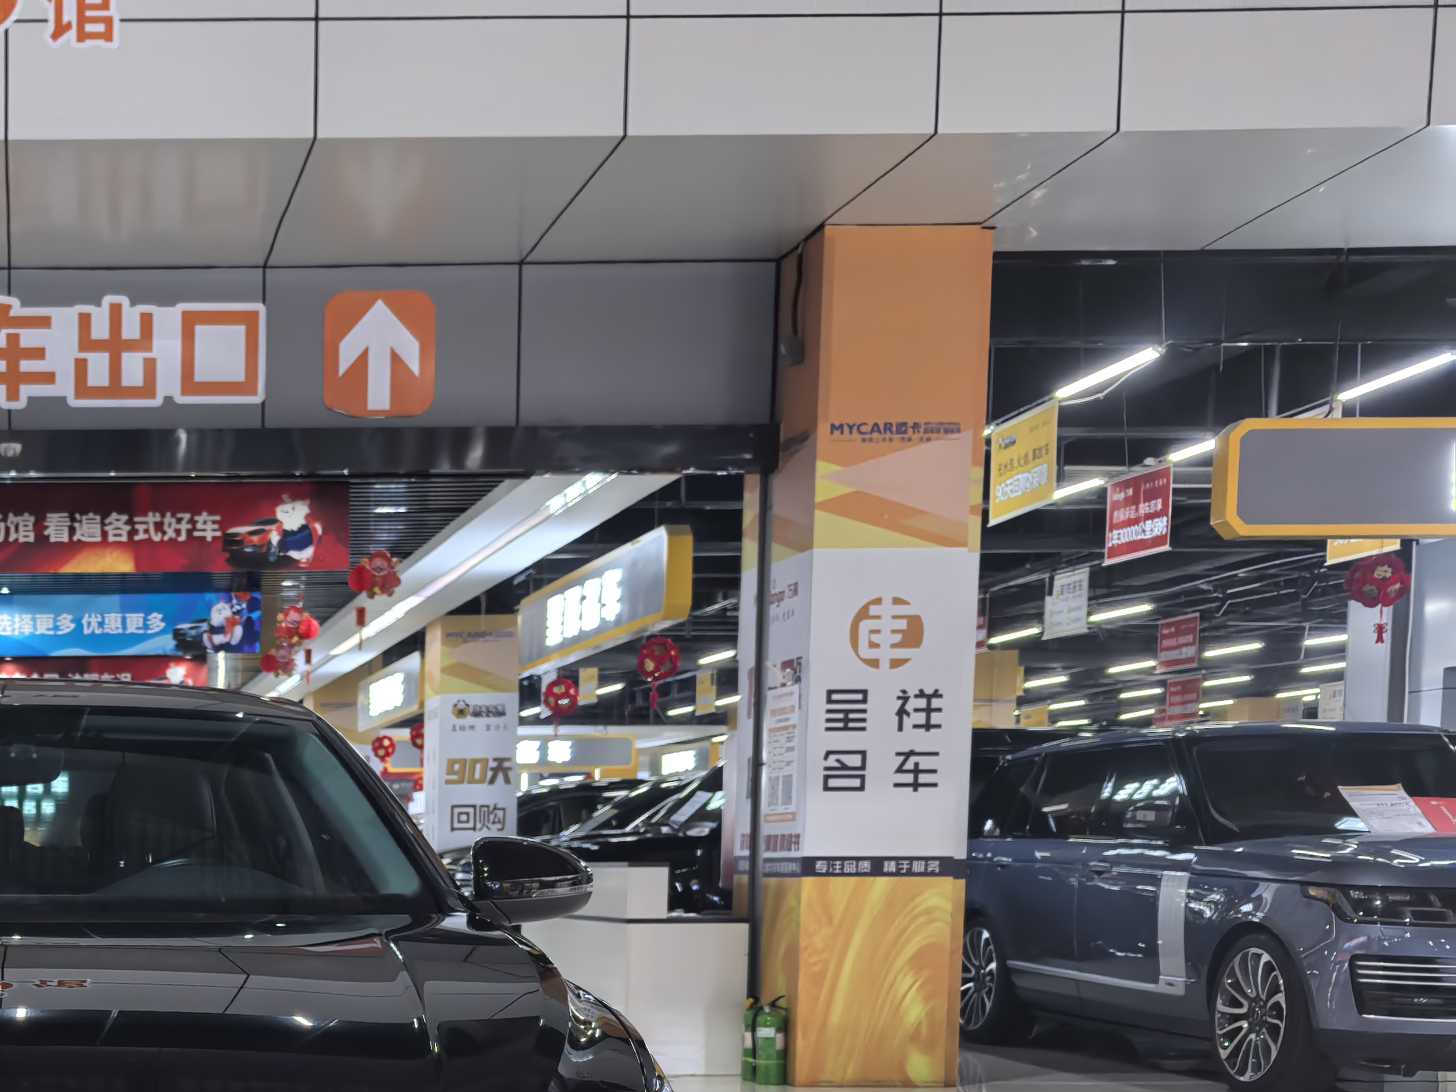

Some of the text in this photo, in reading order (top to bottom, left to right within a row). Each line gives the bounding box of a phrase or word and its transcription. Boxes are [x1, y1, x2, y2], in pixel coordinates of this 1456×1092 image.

[43, 510, 222, 544] 看遍各式好车
[82, 611, 167, 635] 优惠更多
[825, 688, 944, 733] 呈祥
[445, 757, 512, 785] 90天
[822, 748, 940, 793] 名车
[450, 803, 507, 832] 回购
[815, 860, 871, 873] 专注品质
[883, 860, 940, 873] 精于服务
